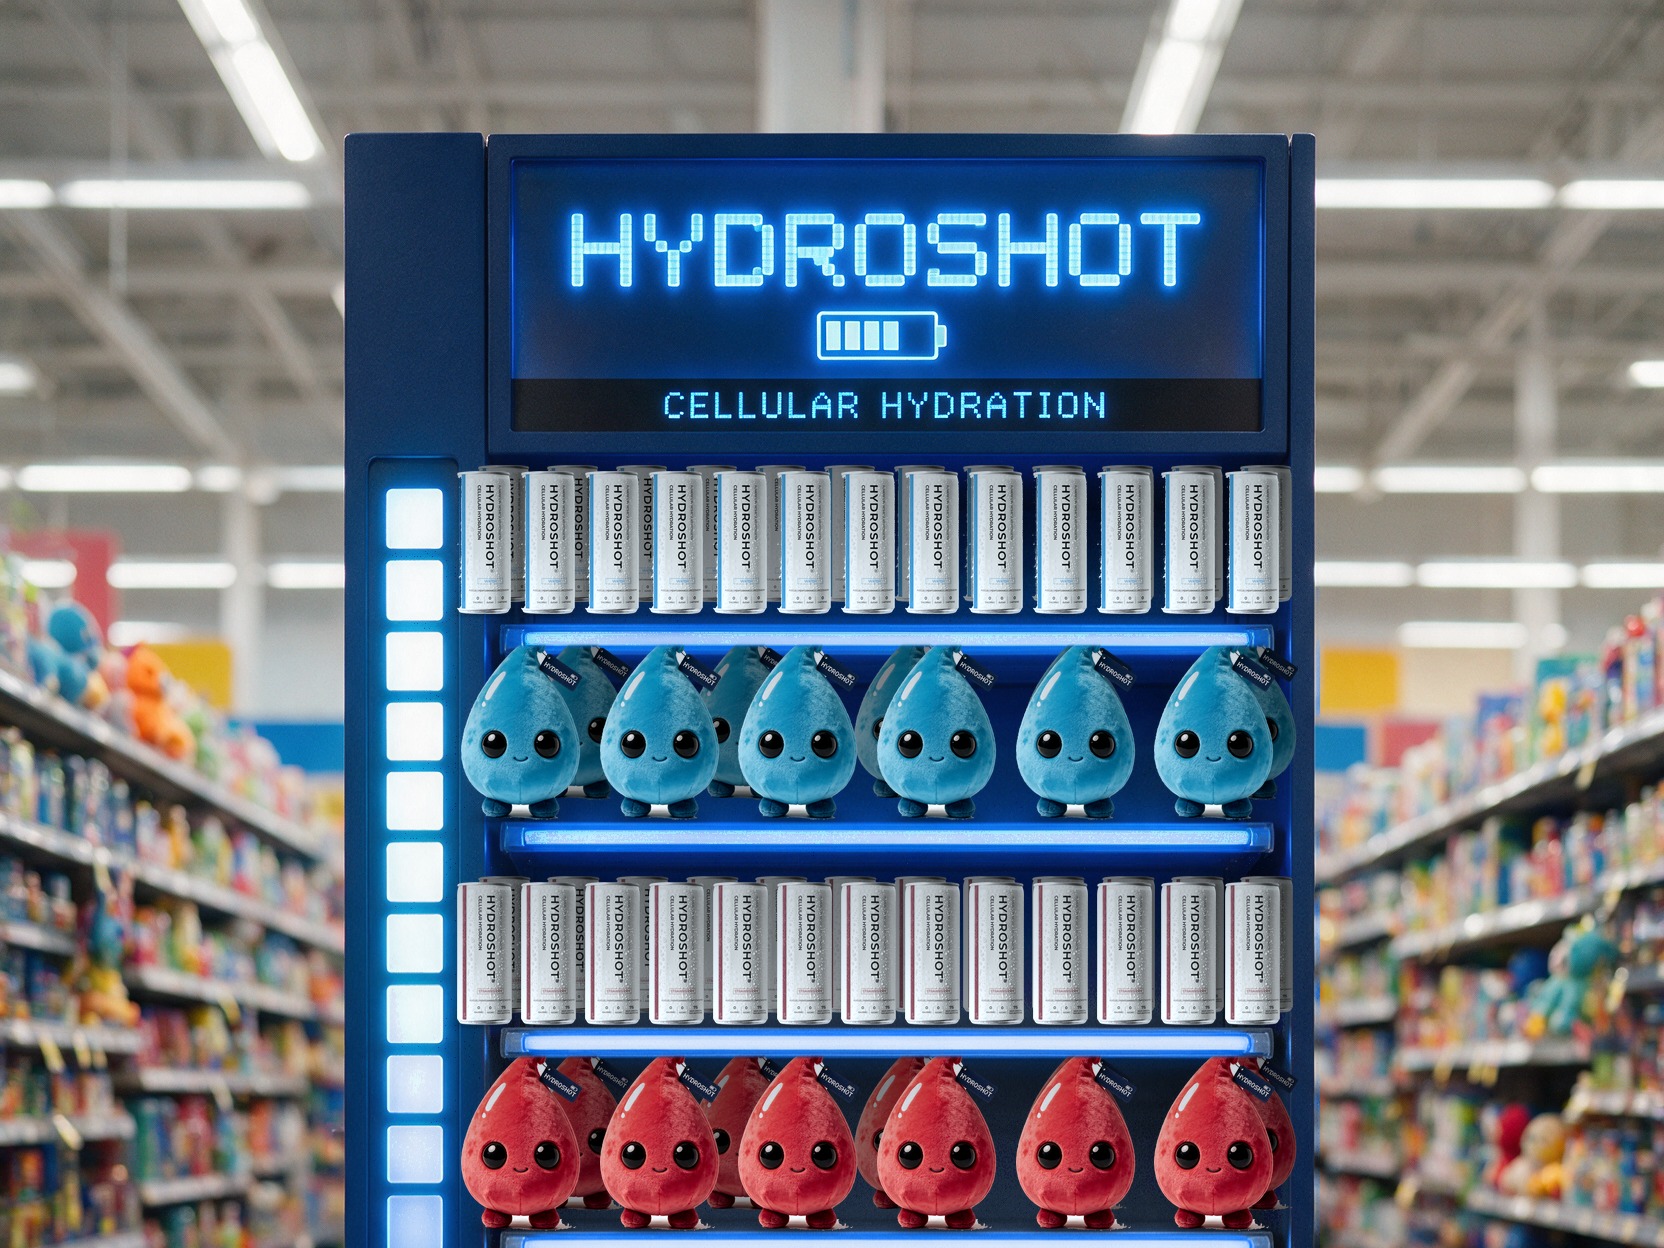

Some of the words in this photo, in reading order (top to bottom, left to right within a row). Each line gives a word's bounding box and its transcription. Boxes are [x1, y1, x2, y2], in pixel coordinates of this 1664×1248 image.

[570, 212, 1202, 289] HYDROSHOT
[664, 391, 859, 420] CELLULAR
[881, 391, 1106, 420] HYDRATION
[543, 661, 577, 686] HYDROSHOT
[682, 661, 716, 686] HYDROSHOT
[820, 661, 854, 686] HYDROSHOT
[959, 661, 993, 686] HYDROSHOT
[1098, 661, 1132, 686] HYDROSHOT
[1236, 661, 1270, 686] HYDROSHOT
[543, 1072, 577, 1097] HYDROSHOT
[682, 1072, 716, 1097] HYDROSHOT
[820, 1072, 854, 1097] HYDROSHOT
[959, 1072, 993, 1097] HYDROSHOT
[1098, 1072, 1132, 1097] HYDROSHOT
[1236, 1072, 1270, 1097] HYDROSHOT
